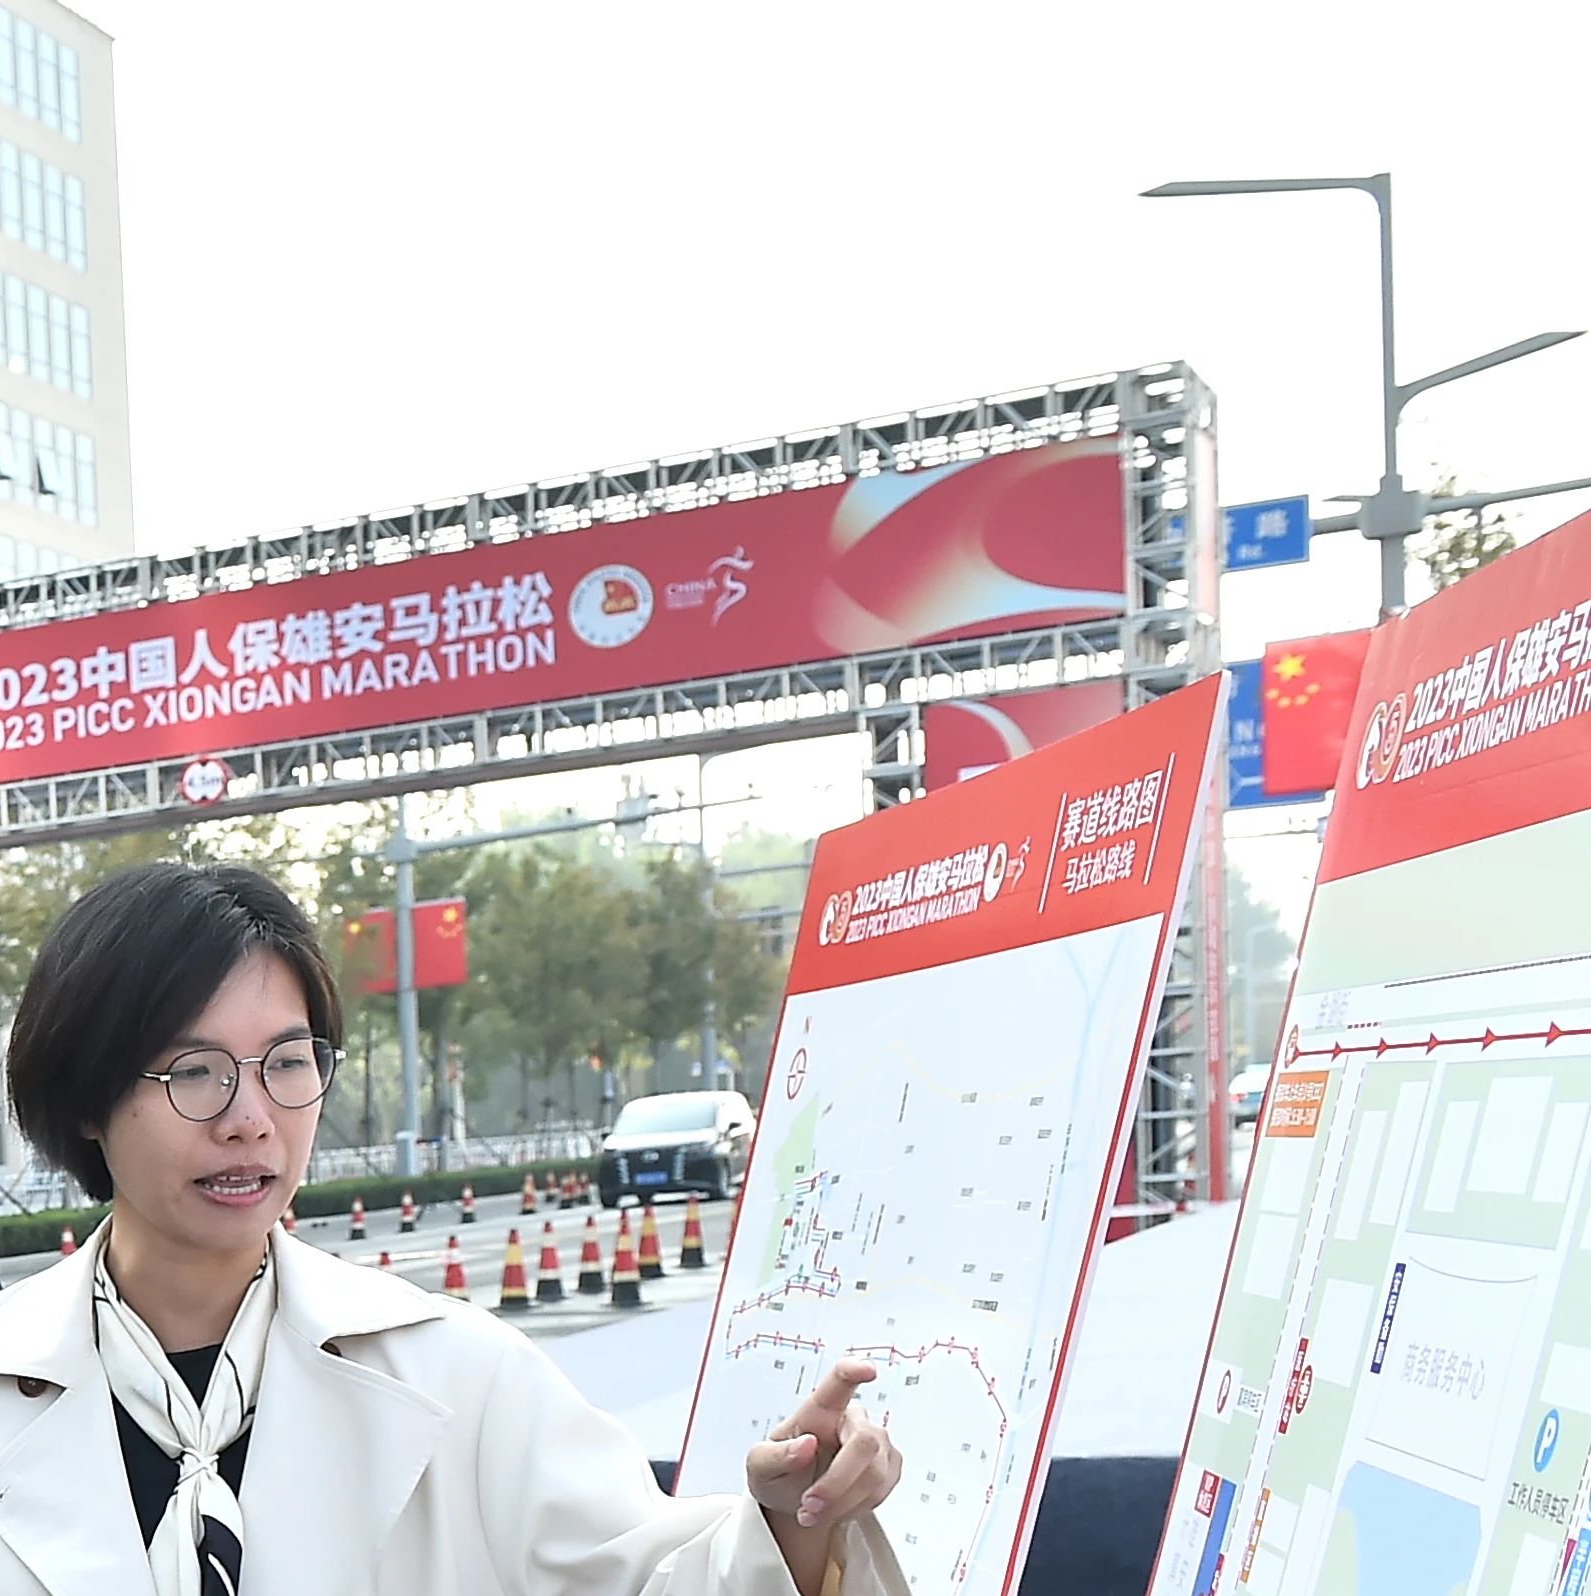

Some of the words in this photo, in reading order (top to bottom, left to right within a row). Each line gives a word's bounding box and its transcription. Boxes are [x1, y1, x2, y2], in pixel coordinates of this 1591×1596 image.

[53, 698, 136, 742] PICC
[143, 667, 312, 729] XIONGAN
[321, 628, 557, 700] MARATHON
[1393, 735, 1429, 783] 2023
[1424, 725, 1460, 772] PICC
[1455, 695, 1526, 761] XIONGAN
[1061, 769, 1163, 851] 赛道线路图
[851, 844, 991, 917] 2023中国人保雄安马拉松
[1062, 839, 1136, 894] 马拉松路线
[1507, 1481, 1570, 1524] 工作人员停车区
